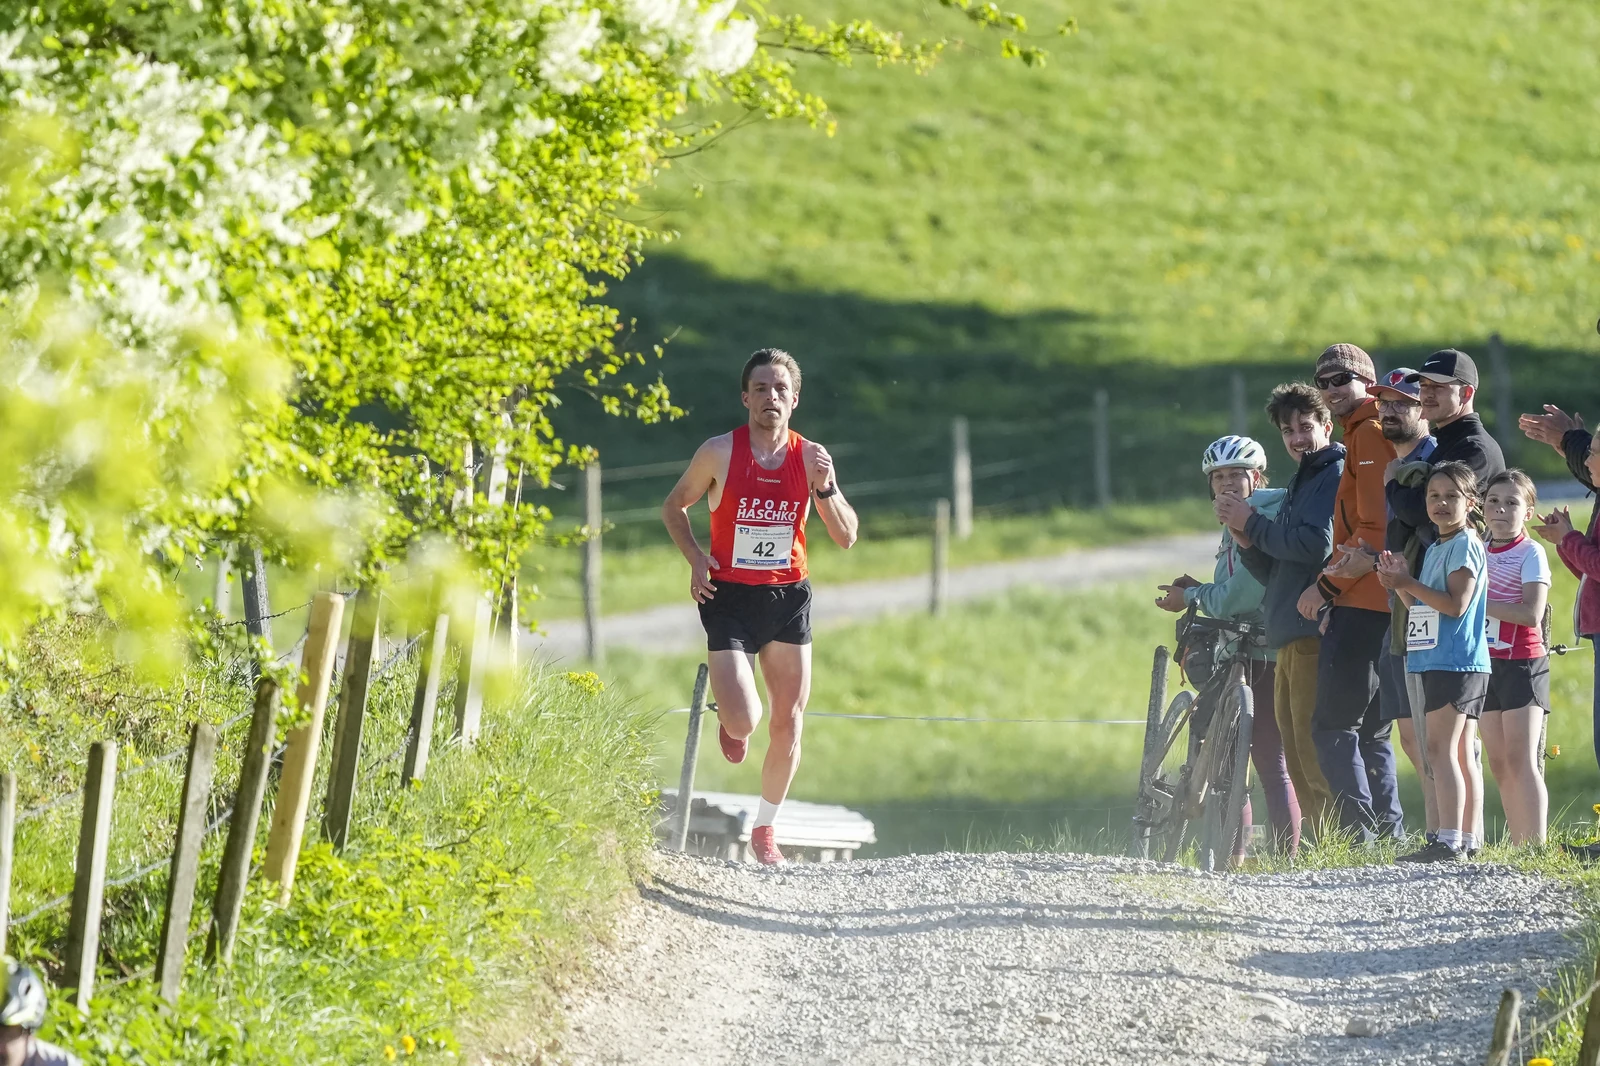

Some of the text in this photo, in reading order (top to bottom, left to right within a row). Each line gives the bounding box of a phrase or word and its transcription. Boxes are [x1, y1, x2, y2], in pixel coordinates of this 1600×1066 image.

[739, 497, 800, 512] SPORT
[736, 508, 798, 522] HASCHKO
[752, 541, 775, 558] 42
